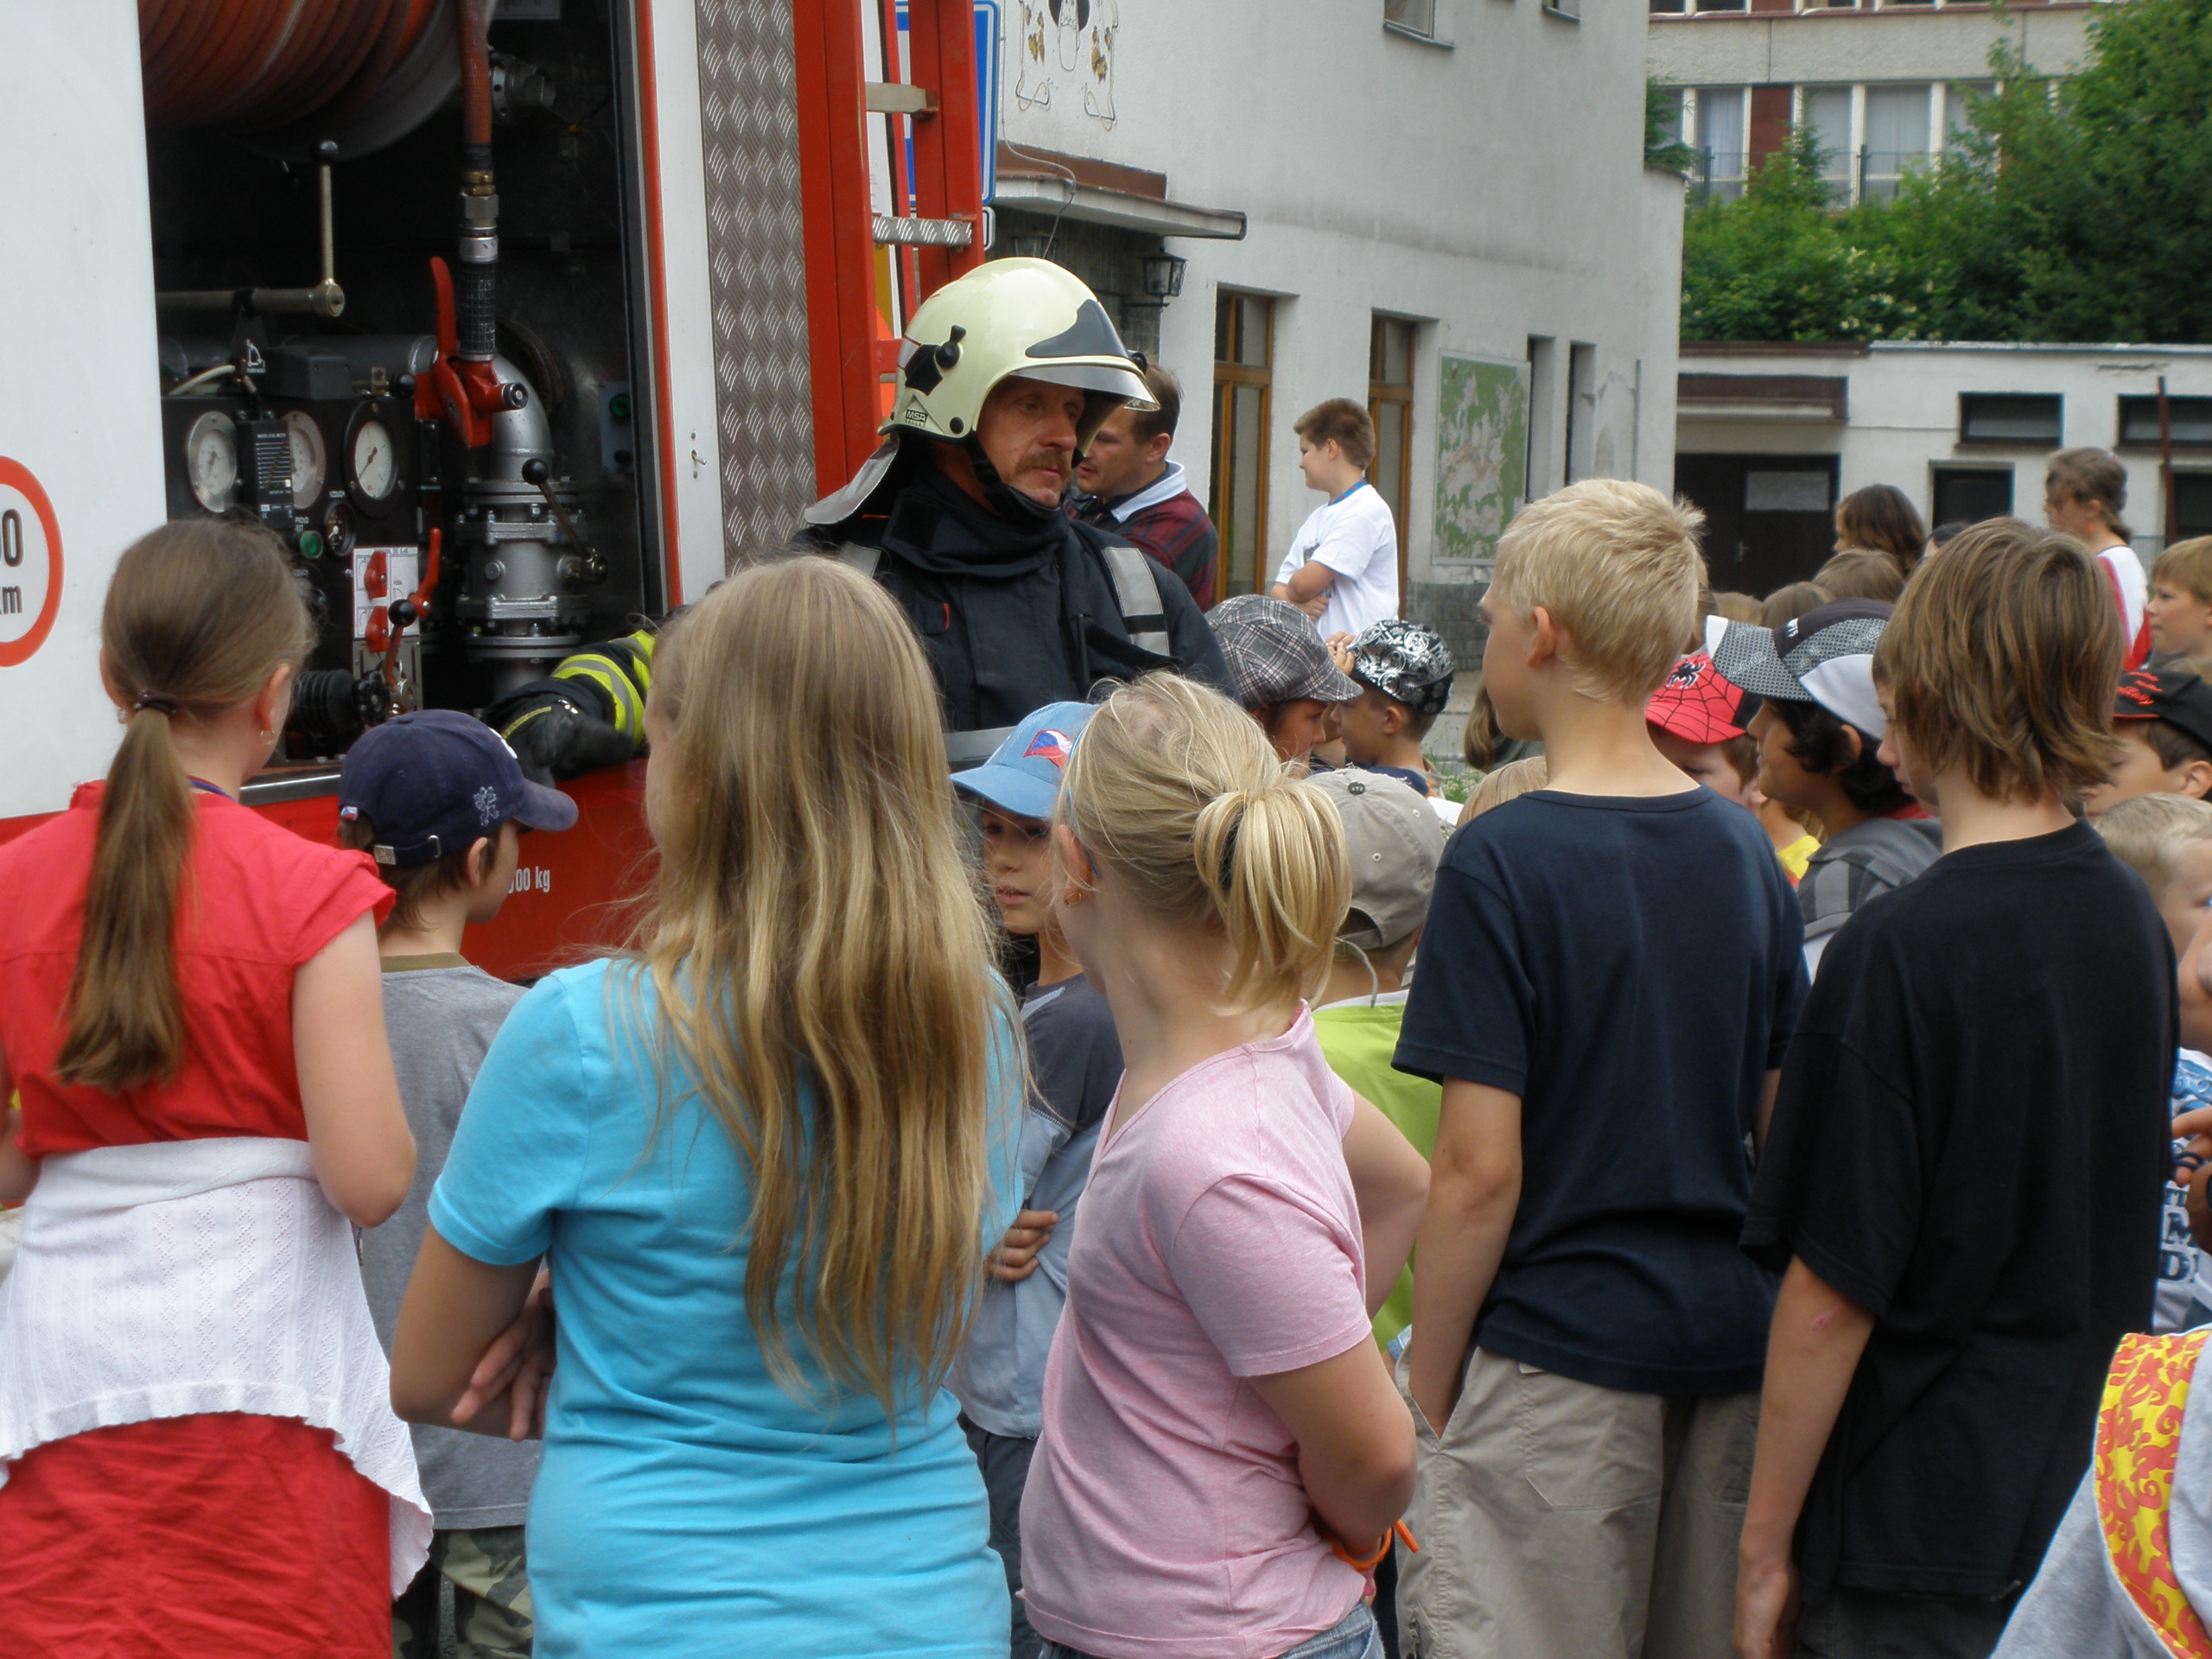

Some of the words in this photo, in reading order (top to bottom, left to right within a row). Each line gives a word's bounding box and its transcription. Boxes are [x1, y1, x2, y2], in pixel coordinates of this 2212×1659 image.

[906, 410, 926, 422] MSA
[0, 508, 23, 568] 0
[0, 585, 22, 615] m
[535, 866, 550, 893] kg
